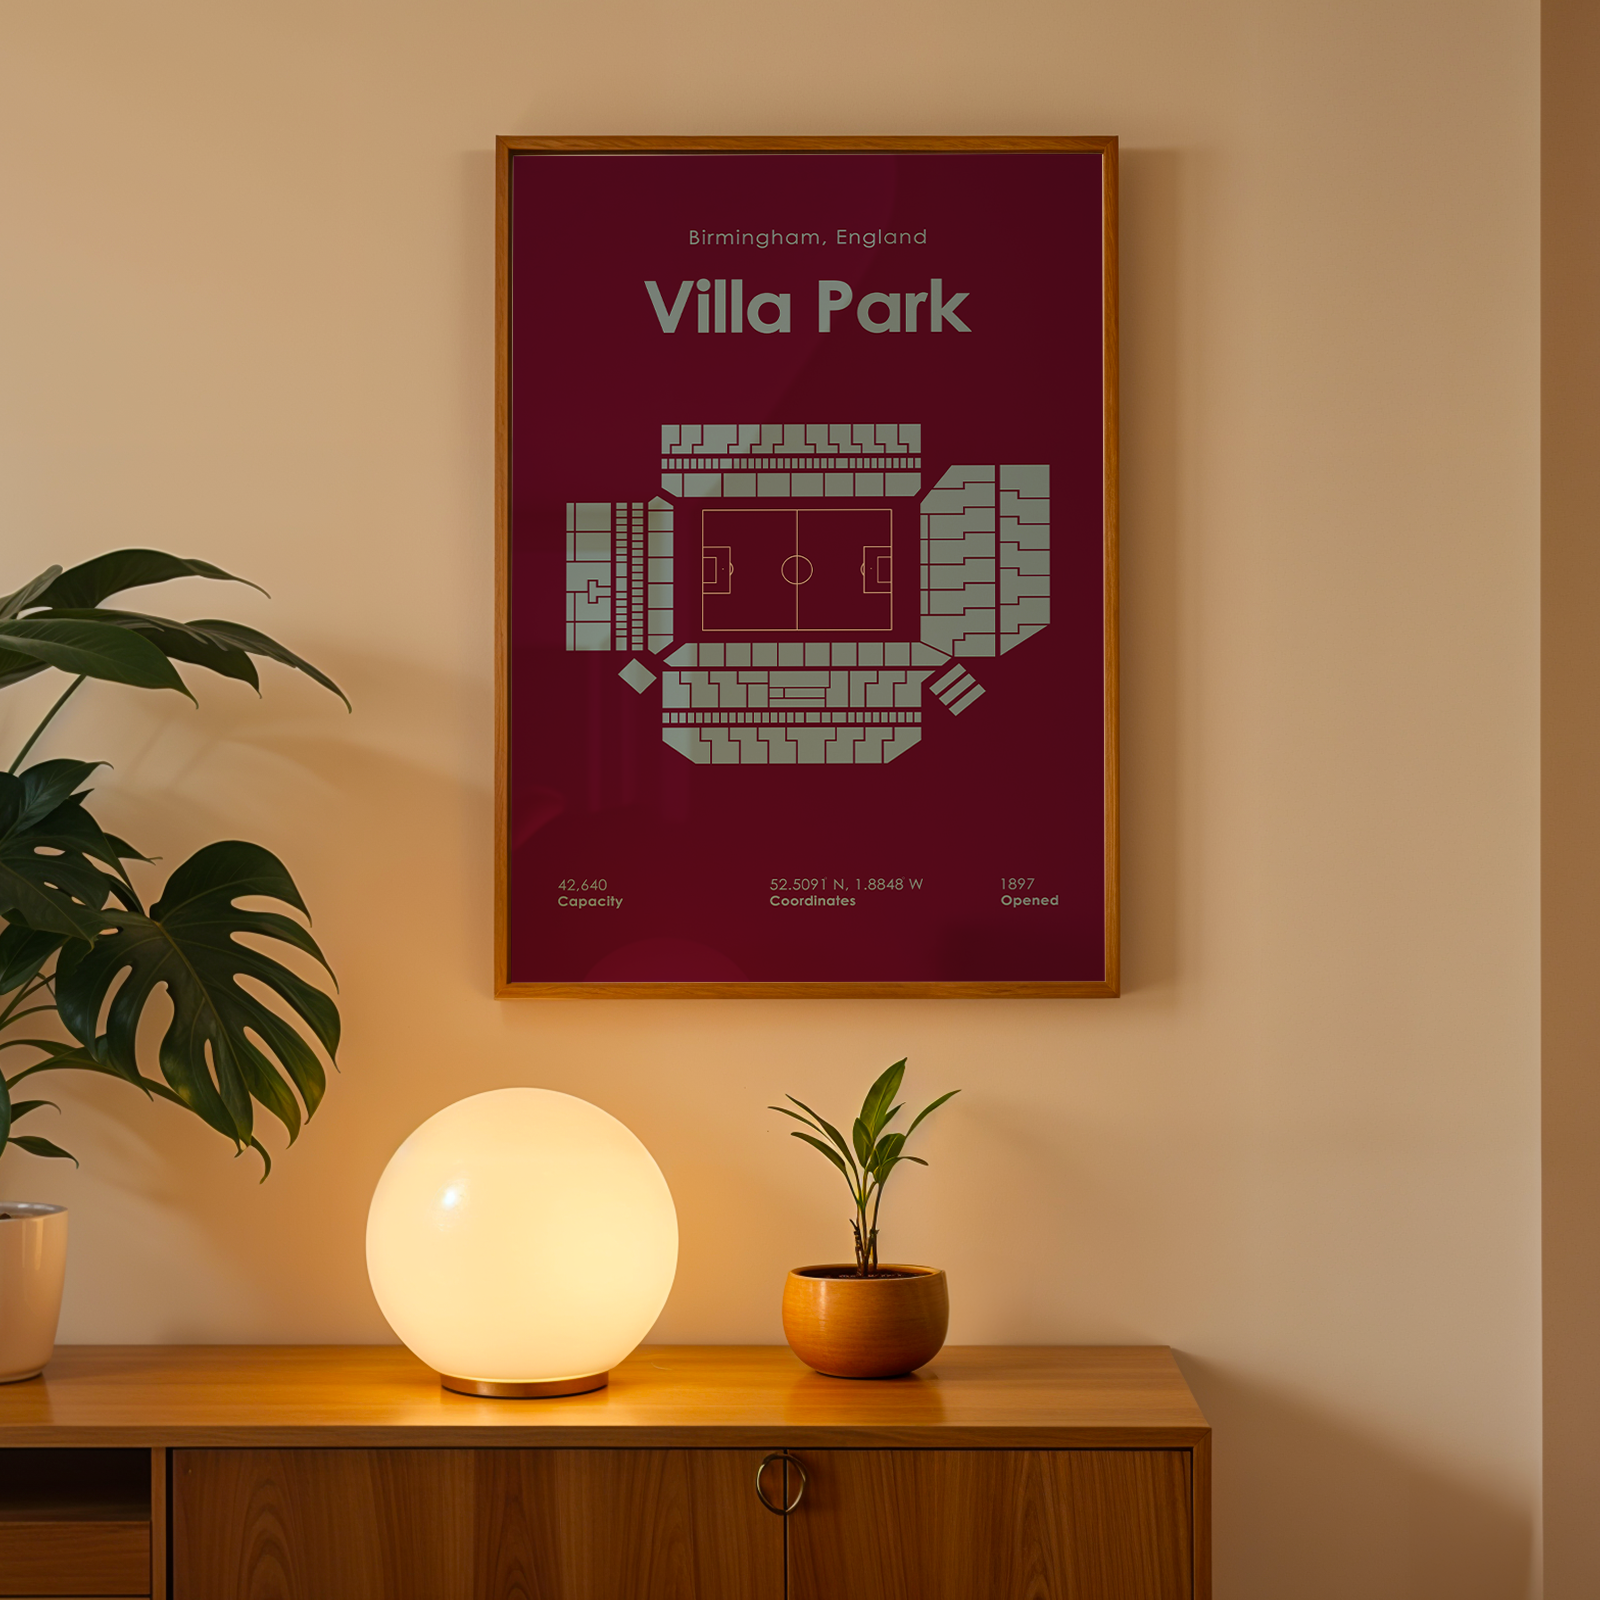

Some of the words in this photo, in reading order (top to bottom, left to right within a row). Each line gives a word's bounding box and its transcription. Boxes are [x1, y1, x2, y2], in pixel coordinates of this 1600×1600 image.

[689, 229, 827, 249] Birmingham,
[836, 228, 927, 249] England
[644, 278, 791, 334] Villa
[818, 278, 973, 334] Park
[557, 878, 608, 892] 42,640
[833, 878, 849, 892] N,
[908, 878, 924, 890] W
[1001, 877, 1035, 891] 1897
[557, 895, 624, 910] Capacity
[769, 894, 857, 907] Coordinates
[1000, 894, 1059, 909] Opened
